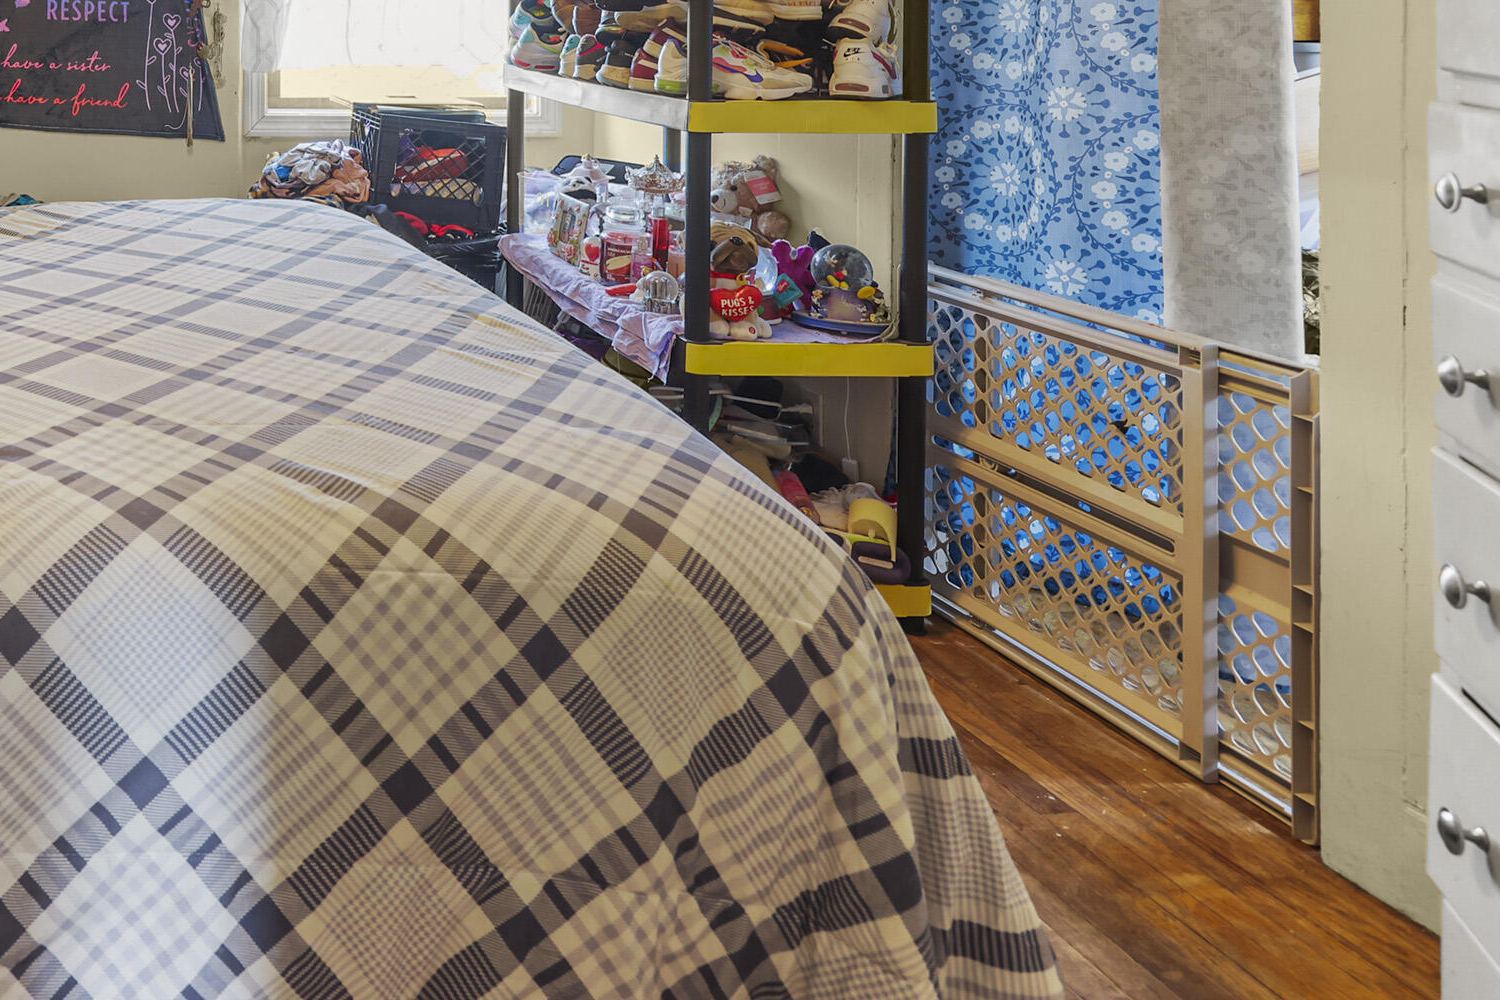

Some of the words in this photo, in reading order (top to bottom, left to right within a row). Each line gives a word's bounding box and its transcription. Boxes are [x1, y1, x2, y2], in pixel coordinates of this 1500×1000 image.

[47, 0, 130, 23] RESPECT
[0, 43, 45, 70] have
[49, 61, 62, 70] a
[66, 50, 112, 72] sister
[3, 78, 50, 104] have
[53, 95, 67, 104] a
[71, 82, 131, 116] friend
[720, 296, 746, 308] PUGS
[721, 305, 755, 317] KISSES
